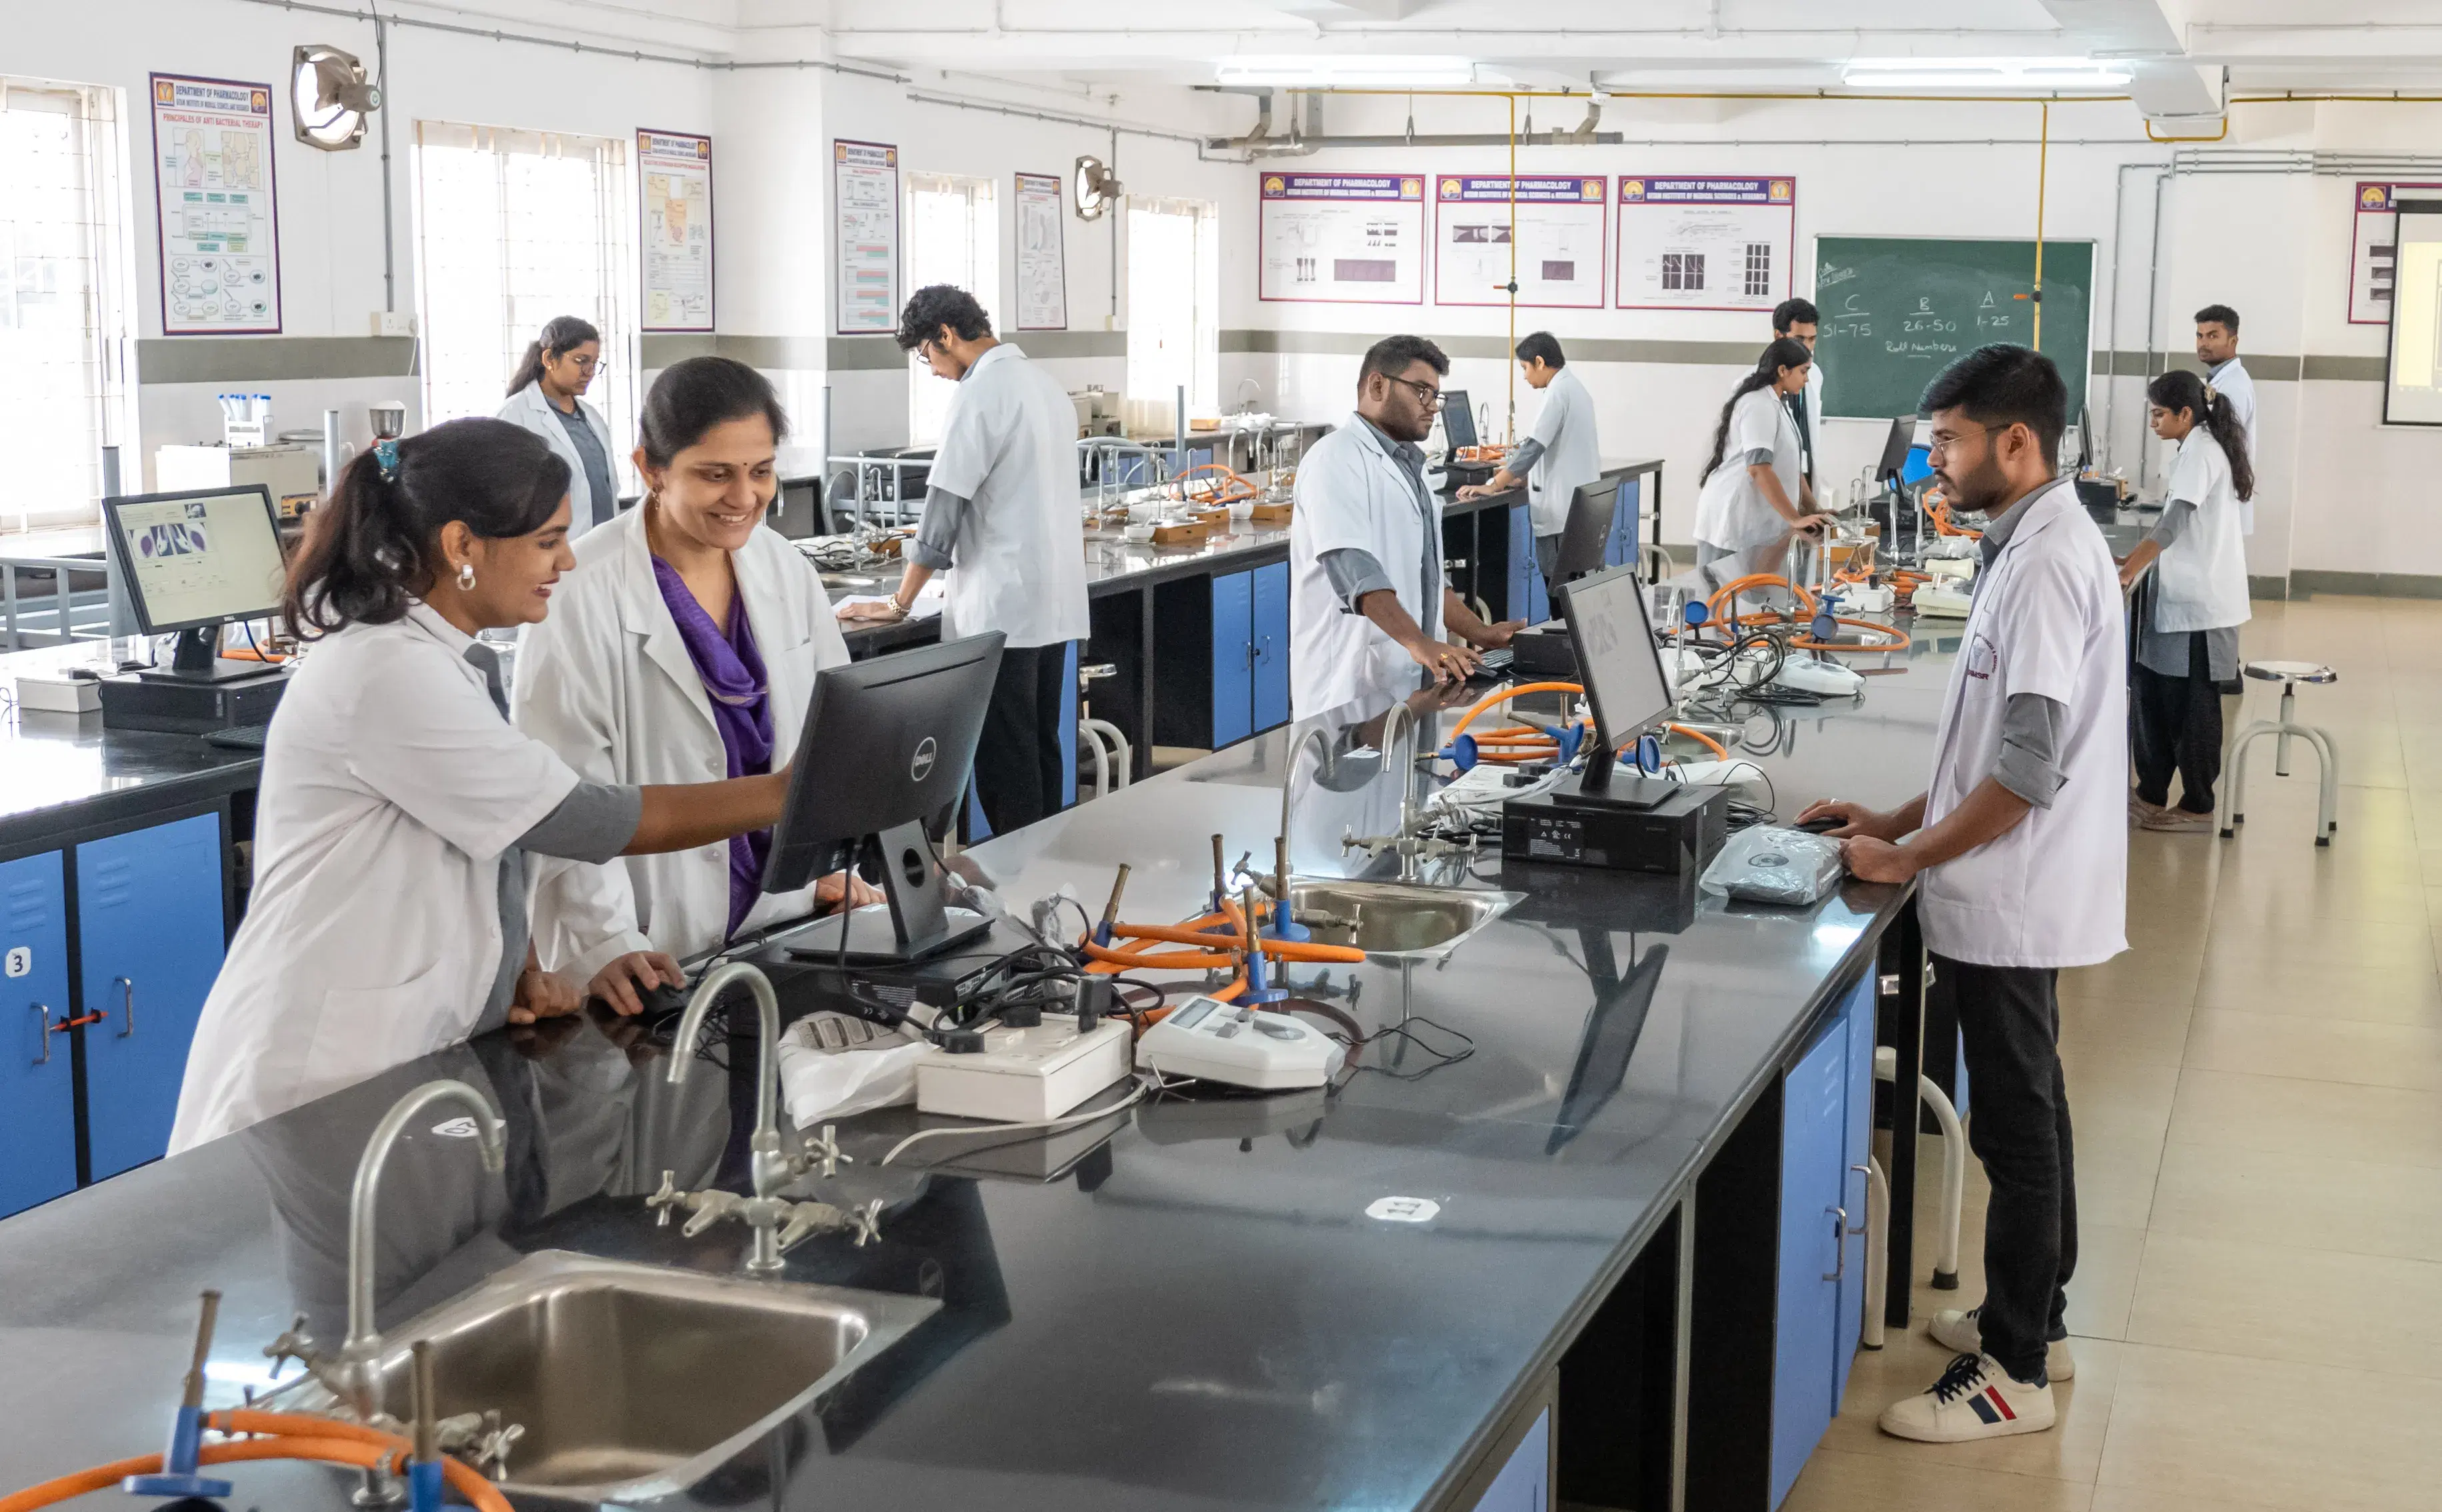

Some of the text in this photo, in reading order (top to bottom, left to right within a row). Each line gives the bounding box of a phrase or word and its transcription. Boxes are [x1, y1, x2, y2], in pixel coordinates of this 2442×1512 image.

[176, 85, 249, 101] DEPARTMENT OF PHARMACOLOGY
[215, 118, 241, 127] BACTERIAL
[243, 120, 264, 129] THERAPY
[1294, 178, 1391, 187] DEPARTMENT OF PHARMACOLOGY
[1471, 180, 1511, 189] DEPARTMENT
[1521, 181, 1571, 189] PHARMACOLOGY
[1655, 181, 1695, 189] DEPARTMENT
[1707, 182, 1758, 190] PHARMACOLOGY
[1845, 294, 1861, 311] C
[1919, 297, 1930, 311] B
[1983, 291, 1995, 305] A
[1903, 319, 1956, 331] 26-50
[1977, 315, 2009, 326] 1-25
[14, 955, 23, 973] 3
